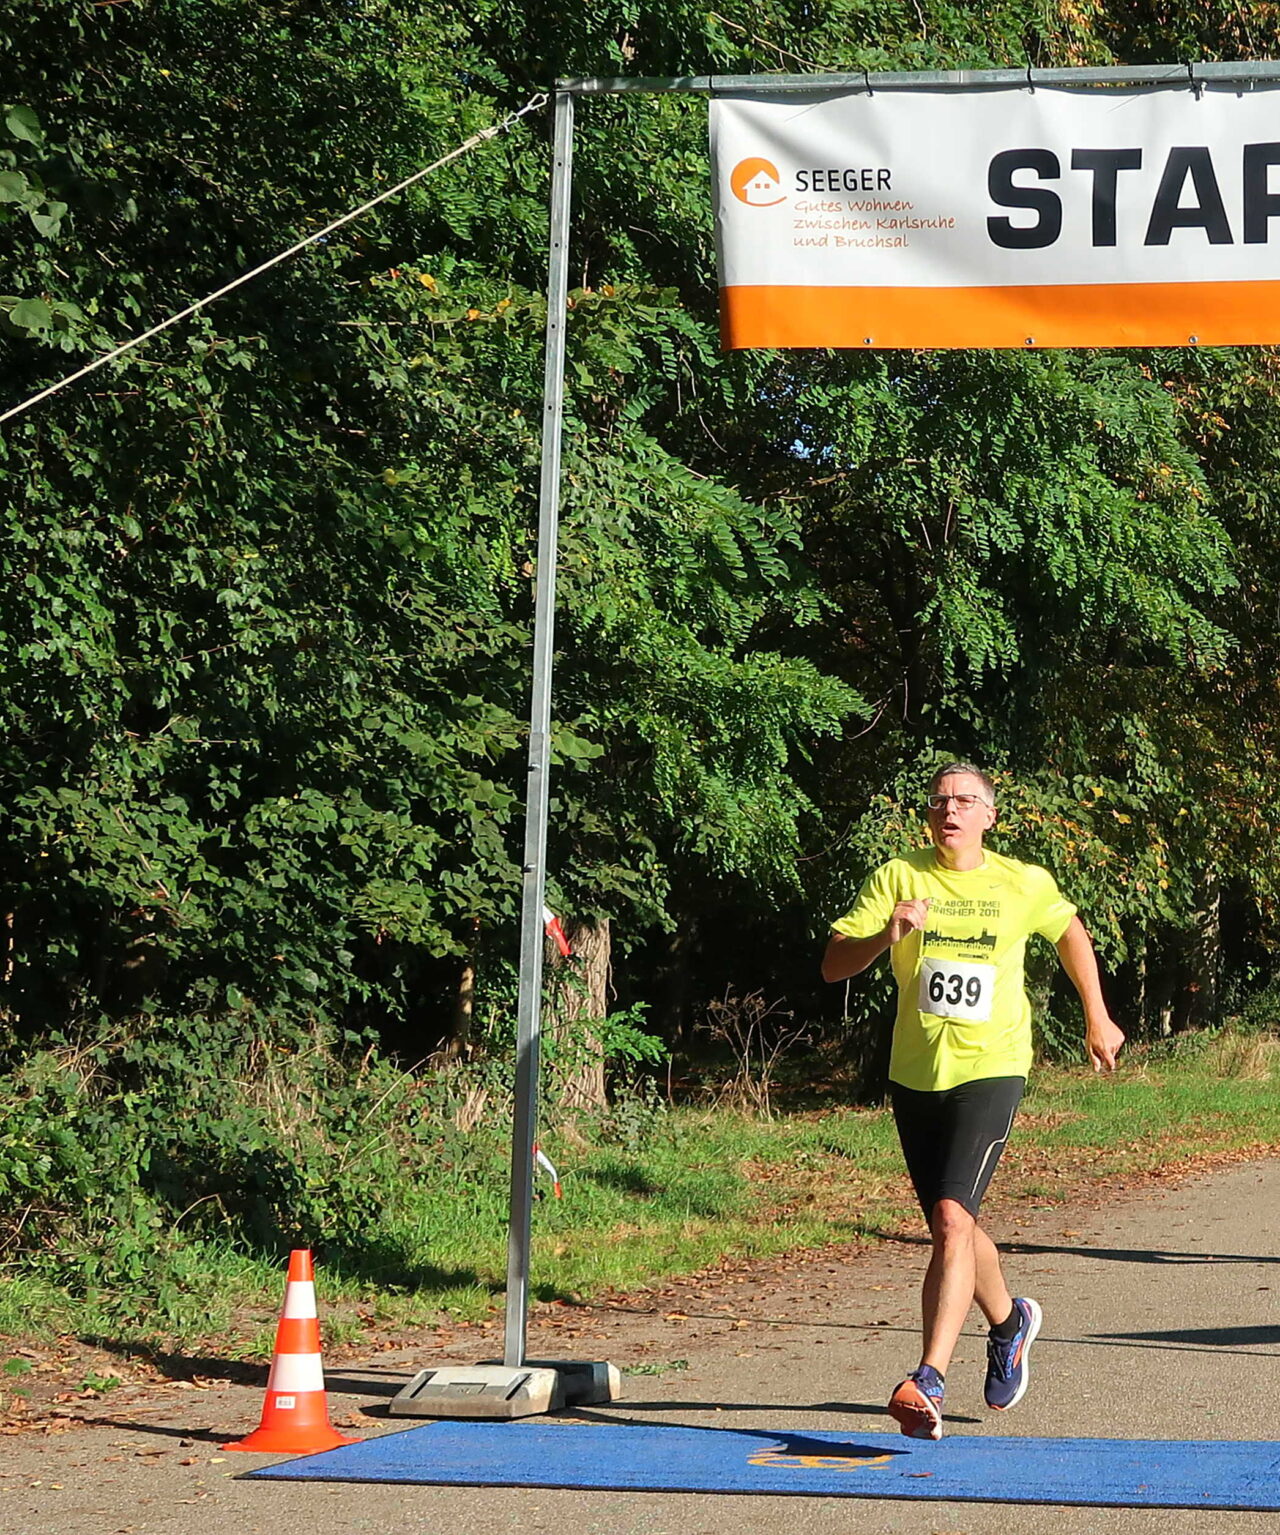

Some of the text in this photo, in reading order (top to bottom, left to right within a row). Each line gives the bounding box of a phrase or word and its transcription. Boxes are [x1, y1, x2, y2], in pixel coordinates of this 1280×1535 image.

[795, 168, 892, 192] SEEGER
[794, 199, 914, 213] Gutes Wohnen
[793, 215, 956, 230] zwischen Karlsruhe
[793, 233, 910, 248] und Bruchsal
[944, 900, 973, 908] ABOUT
[979, 908, 1000, 918] 2011
[929, 971, 981, 1007] 639
